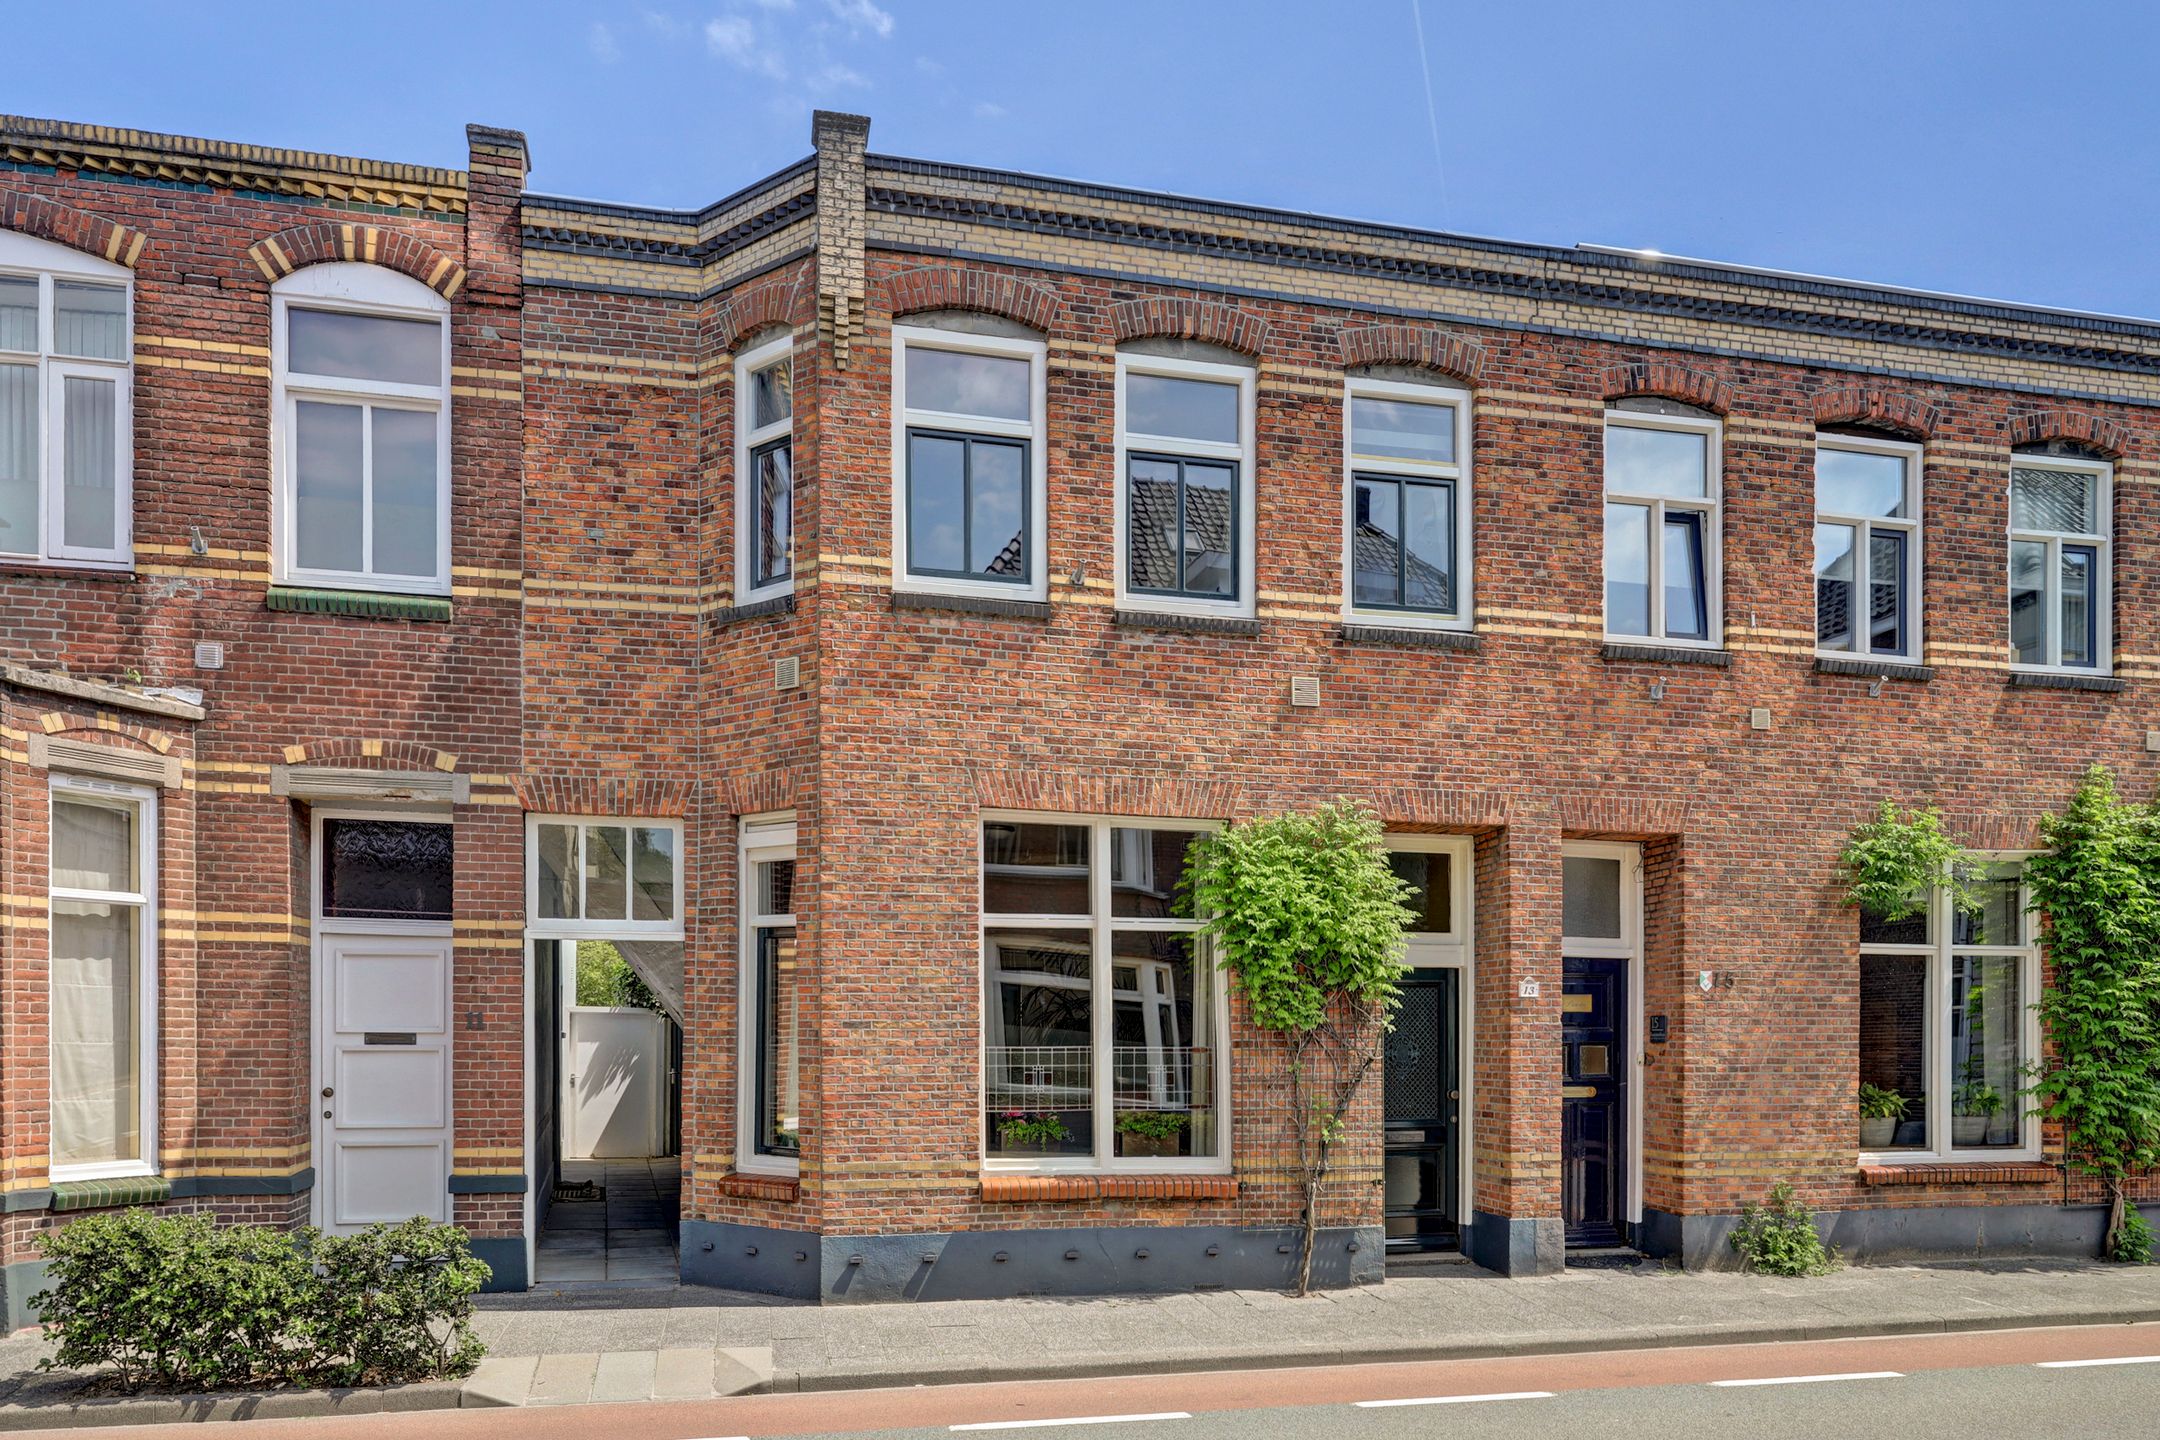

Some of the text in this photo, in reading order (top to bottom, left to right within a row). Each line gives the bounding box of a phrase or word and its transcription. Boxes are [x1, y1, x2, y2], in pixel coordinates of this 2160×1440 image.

[1524, 985, 1535, 996] 13
[465, 1011, 484, 1031] 11
[1651, 1016, 1660, 1029] 15
